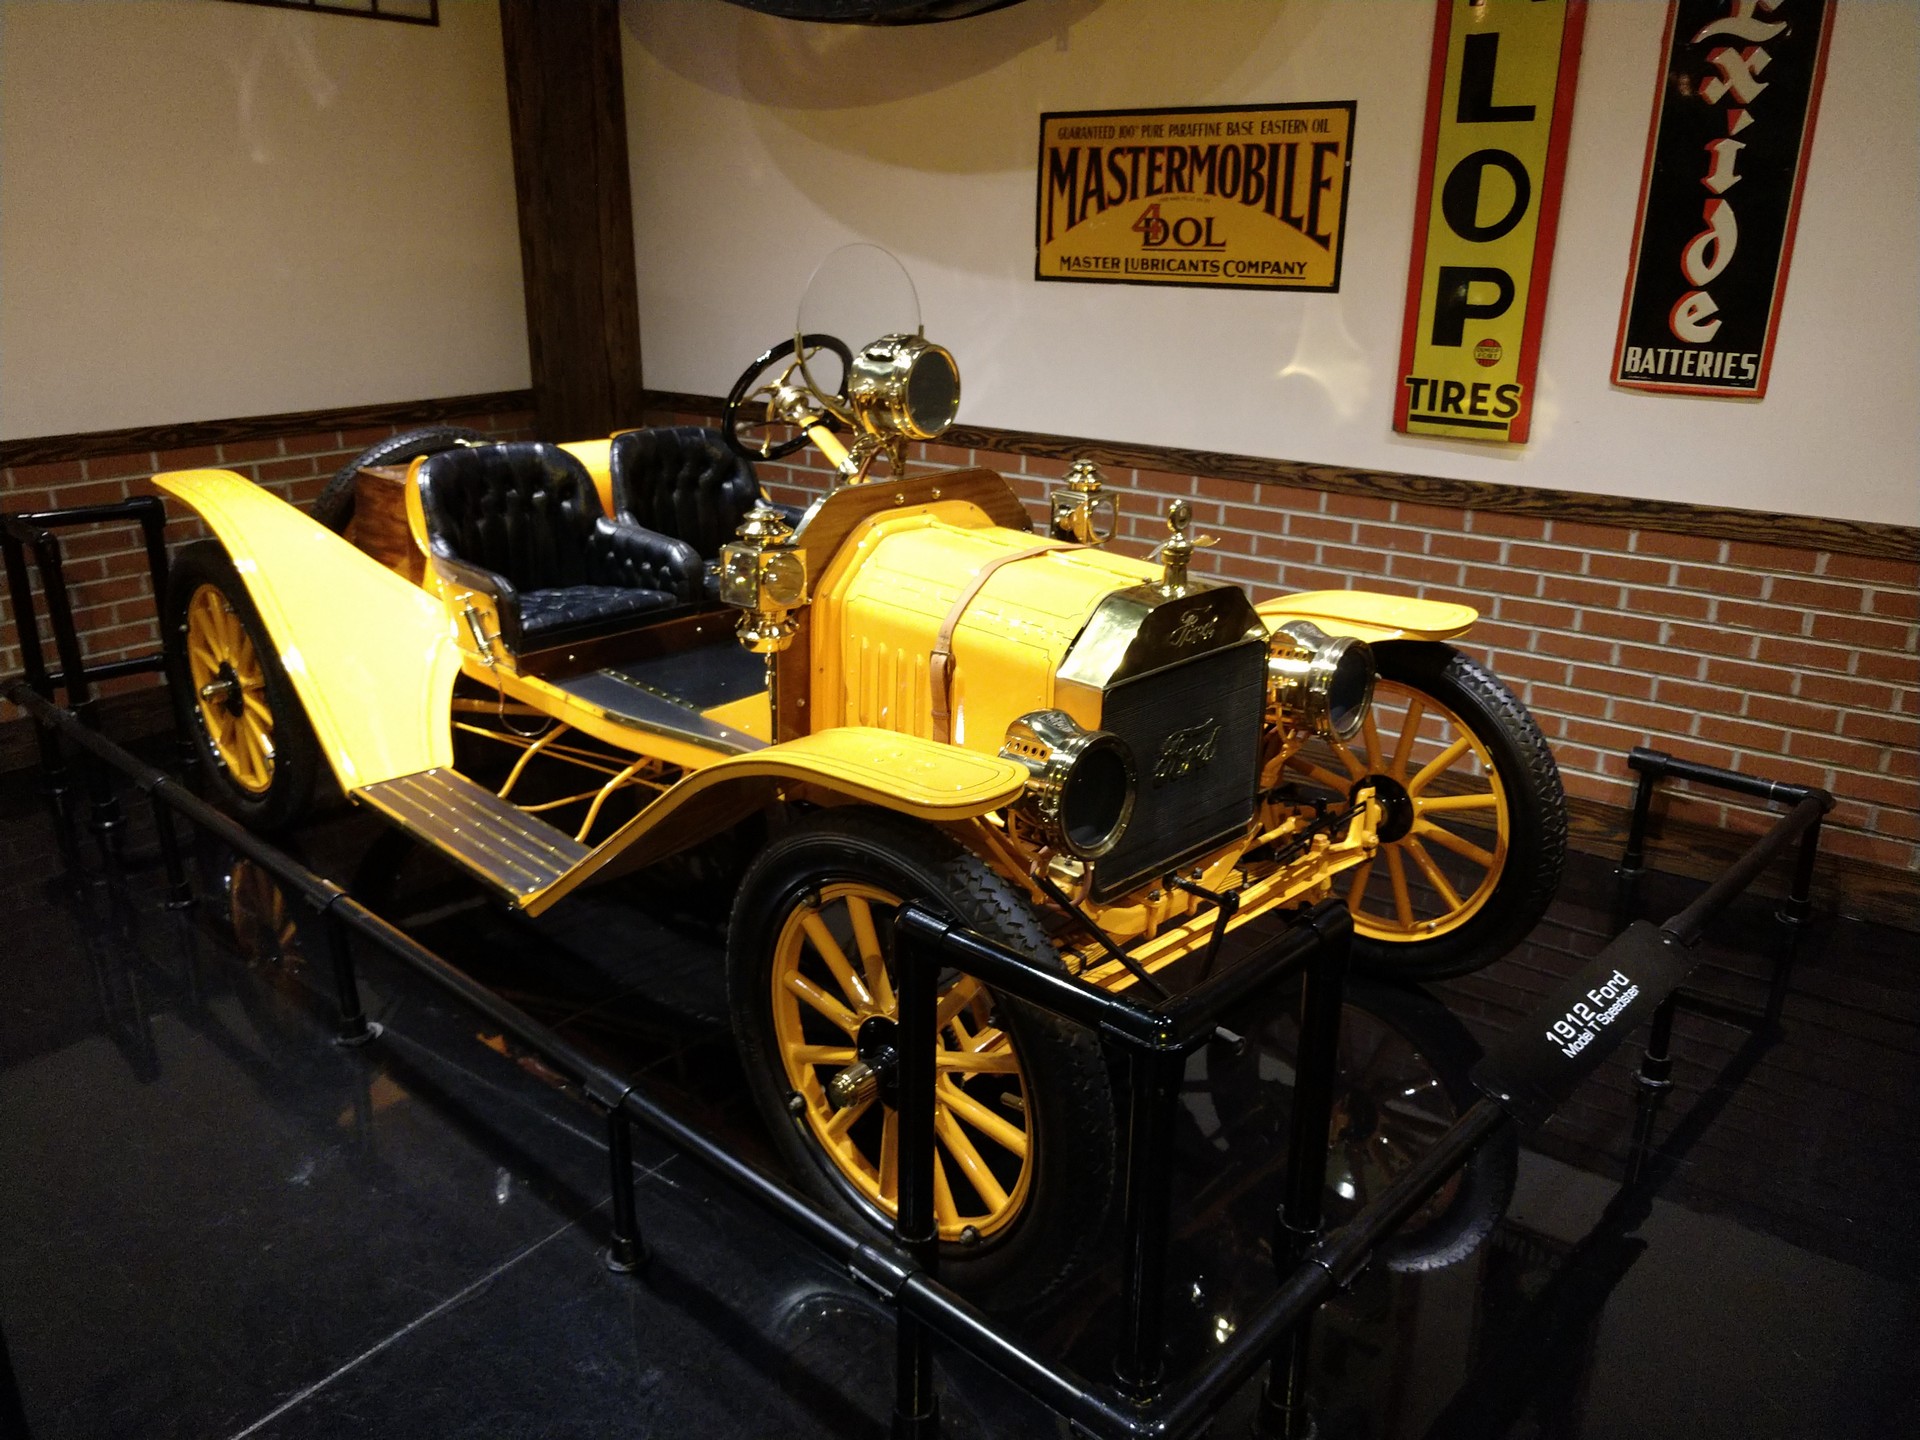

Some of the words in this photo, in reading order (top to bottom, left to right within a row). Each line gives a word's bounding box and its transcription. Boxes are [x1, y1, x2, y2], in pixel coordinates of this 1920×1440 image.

[1057, 126, 1116, 140] GUARANTEED
[1141, 124, 1164, 138] PURE
[1168, 122, 1222, 137] PARAFFINE
[1226, 121, 1254, 136] BASE
[1260, 119, 1308, 135] EASTERN
[1312, 118, 1331, 134] OIL
[1045, 141, 1340, 252] MASTERMOBILE
[1431, 0, 1538, 347] LOP
[1060, 255, 1120, 273] MASTER
[1125, 257, 1220, 276] LUBRICANTS
[1223, 260, 1308, 279] COMPANY
[1625, 346, 1758, 380] BATTERIES
[1406, 377, 1521, 419] TIRES
[1152, 717, 1222, 780] Ford
[1546, 1002, 1596, 1045] 1912
[1587, 969, 1629, 1007] Ford
[1562, 1028, 1595, 1058] Model
[1587, 1020, 1602, 1032] T
[1595, 984, 1640, 1026] Speedster
